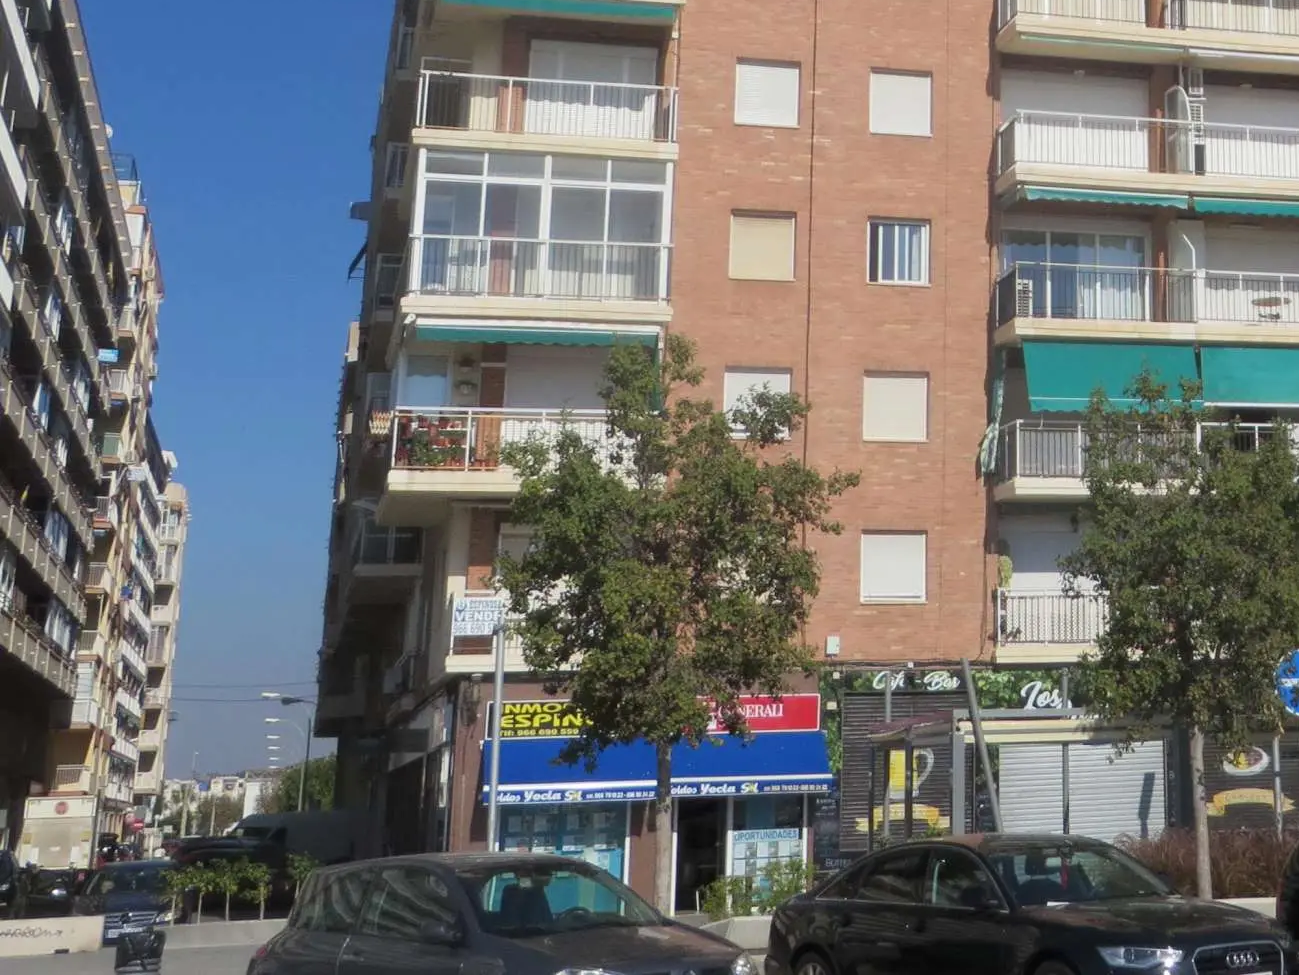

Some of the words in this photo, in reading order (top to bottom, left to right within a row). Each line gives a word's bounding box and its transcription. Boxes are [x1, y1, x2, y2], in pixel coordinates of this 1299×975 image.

[718, 703, 784, 719] NERALI
[671, 784, 697, 795] oldos
[735, 829, 798, 841] OPORTUNIDADES
